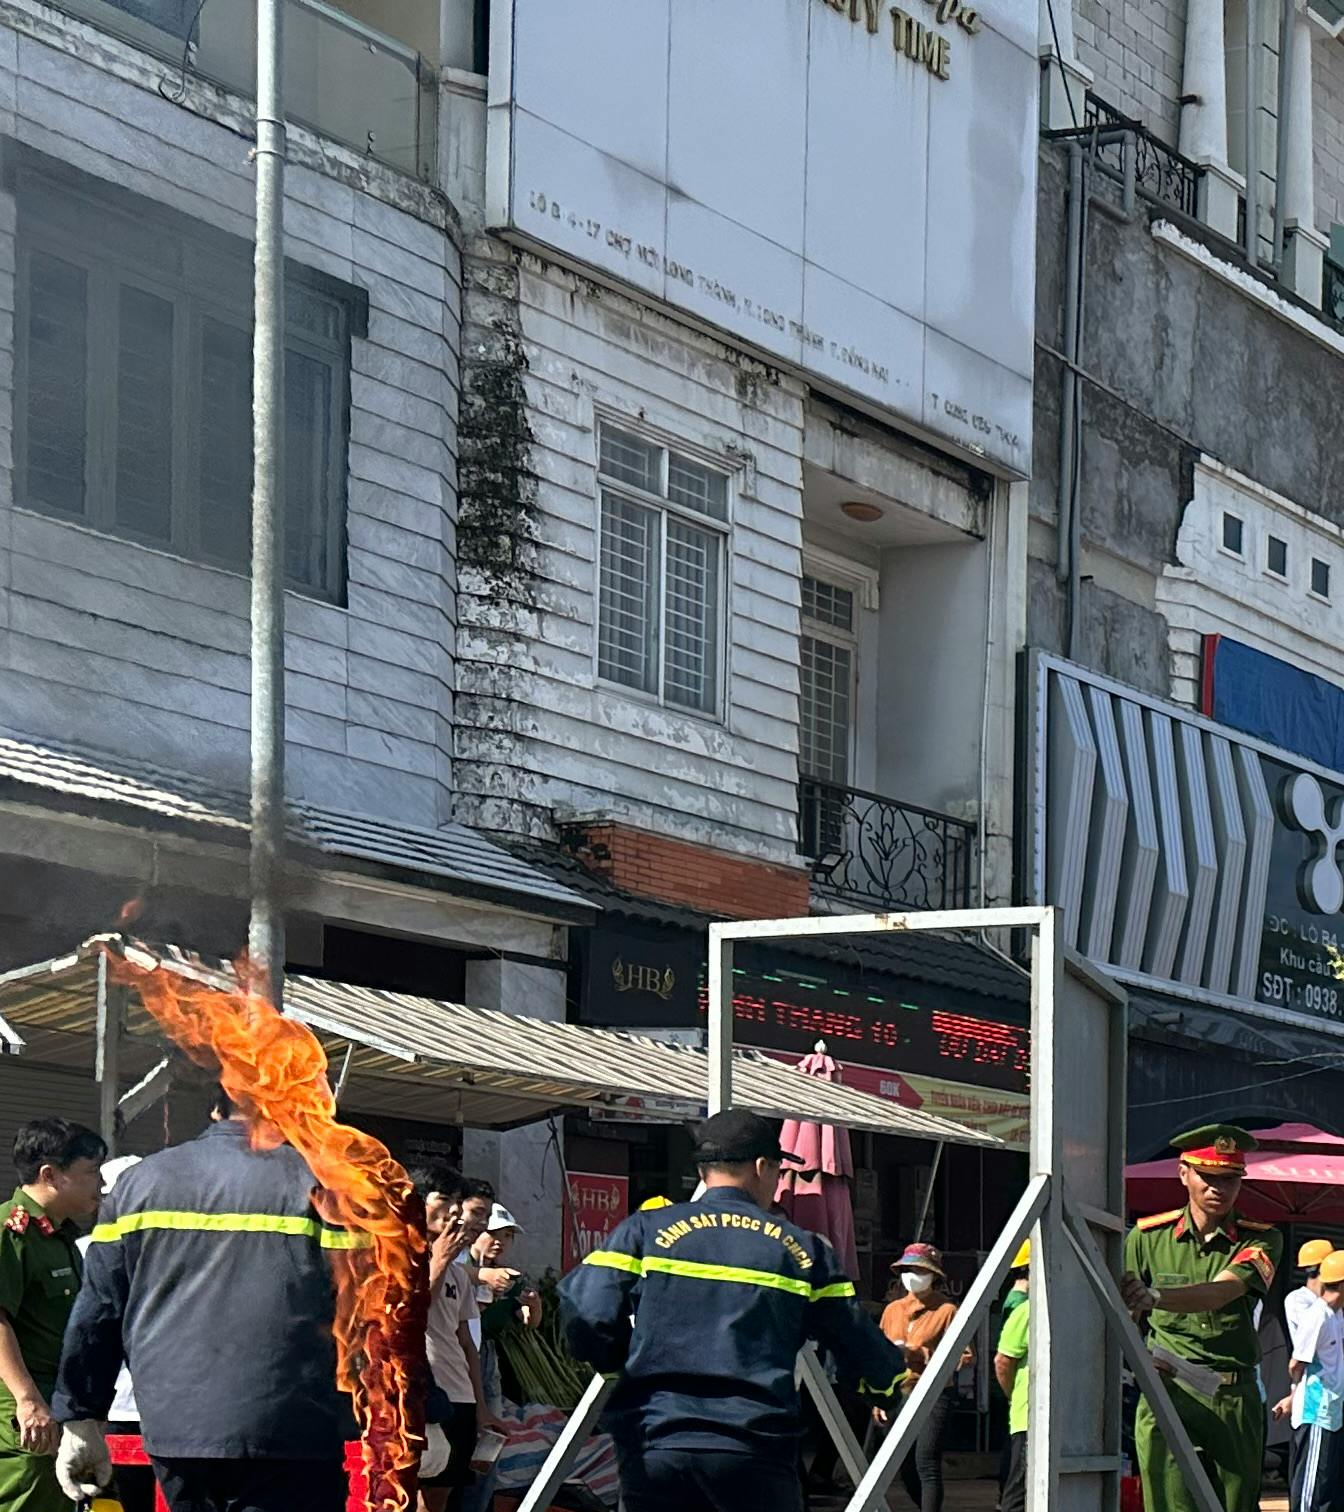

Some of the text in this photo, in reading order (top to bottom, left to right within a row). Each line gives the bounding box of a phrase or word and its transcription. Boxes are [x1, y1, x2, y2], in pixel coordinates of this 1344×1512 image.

[890, 6, 951, 81] TIME
[663, 255, 694, 288] LONG
[1280, 947, 1306, 971] Khu
[1262, 971, 1294, 1003] SĐT
[721, 1213, 761, 1232] PCCC
